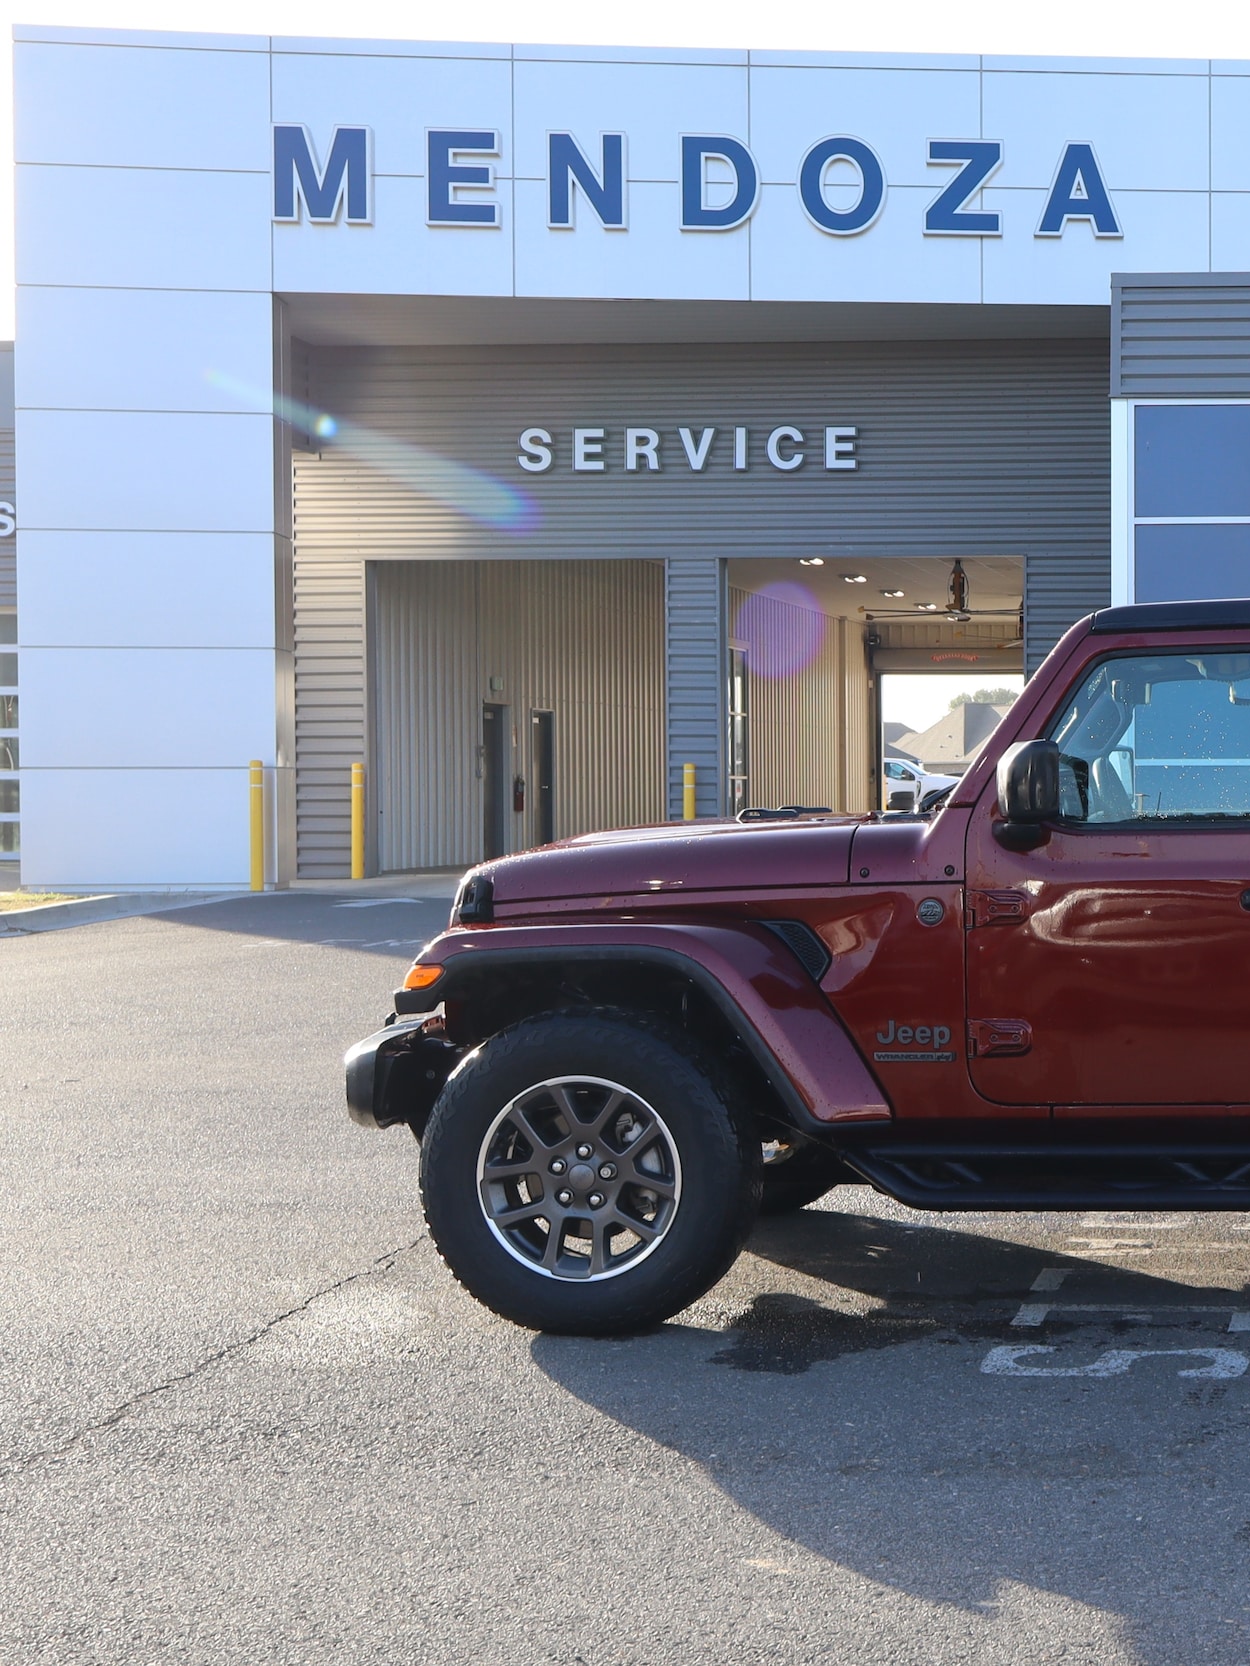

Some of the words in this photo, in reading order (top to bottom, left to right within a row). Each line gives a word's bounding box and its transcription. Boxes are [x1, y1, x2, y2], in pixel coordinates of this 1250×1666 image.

[272, 122, 1124, 238] MENDOZA
[517, 425, 860, 473] SERVICE
[876, 1018, 951, 1050] Jeep
